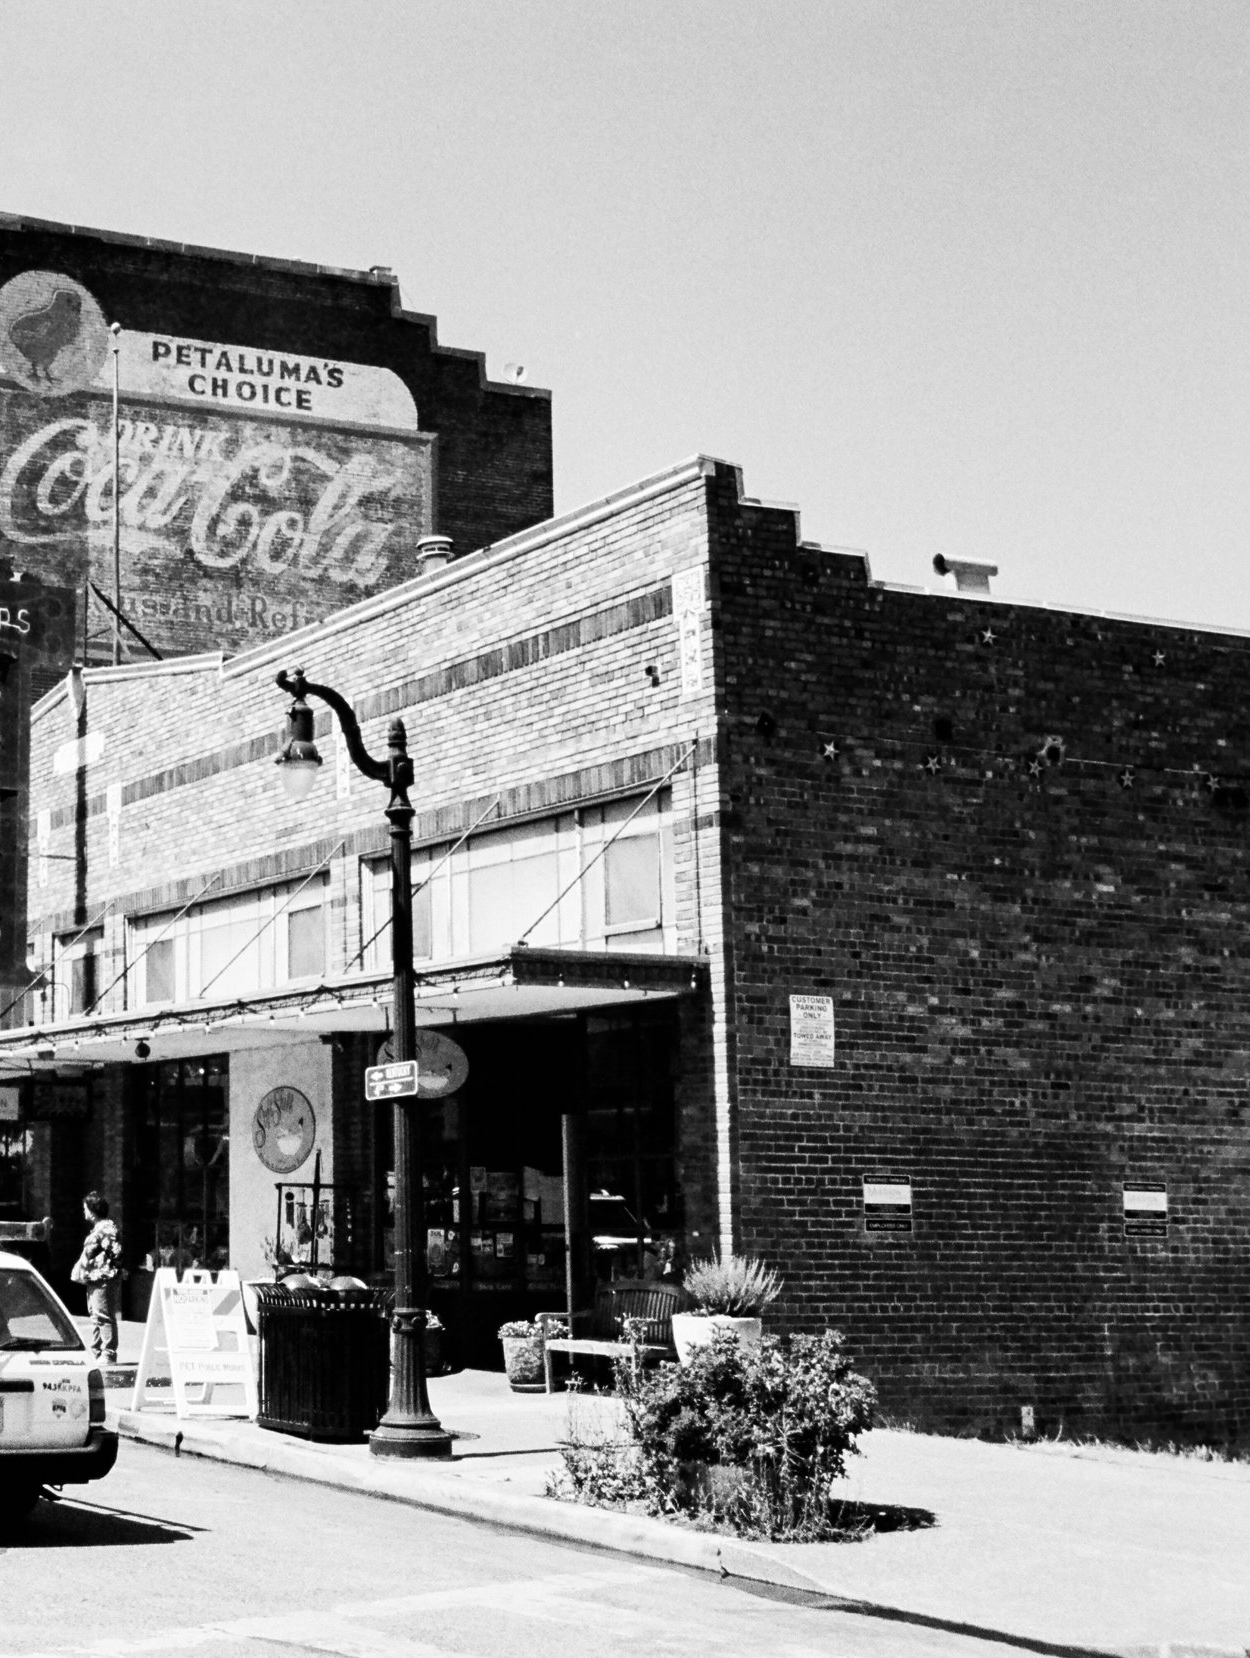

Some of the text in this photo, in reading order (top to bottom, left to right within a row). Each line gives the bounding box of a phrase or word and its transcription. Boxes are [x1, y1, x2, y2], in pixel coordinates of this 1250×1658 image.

[152, 340, 344, 389] PETALUMA'S
[188, 373, 313, 412] CHOICE
[117, 418, 232, 461] DRINK
[791, 995, 831, 1005] CUSTOMER
[796, 1003, 828, 1013] PARKING
[803, 1011, 822, 1020] ONLY
